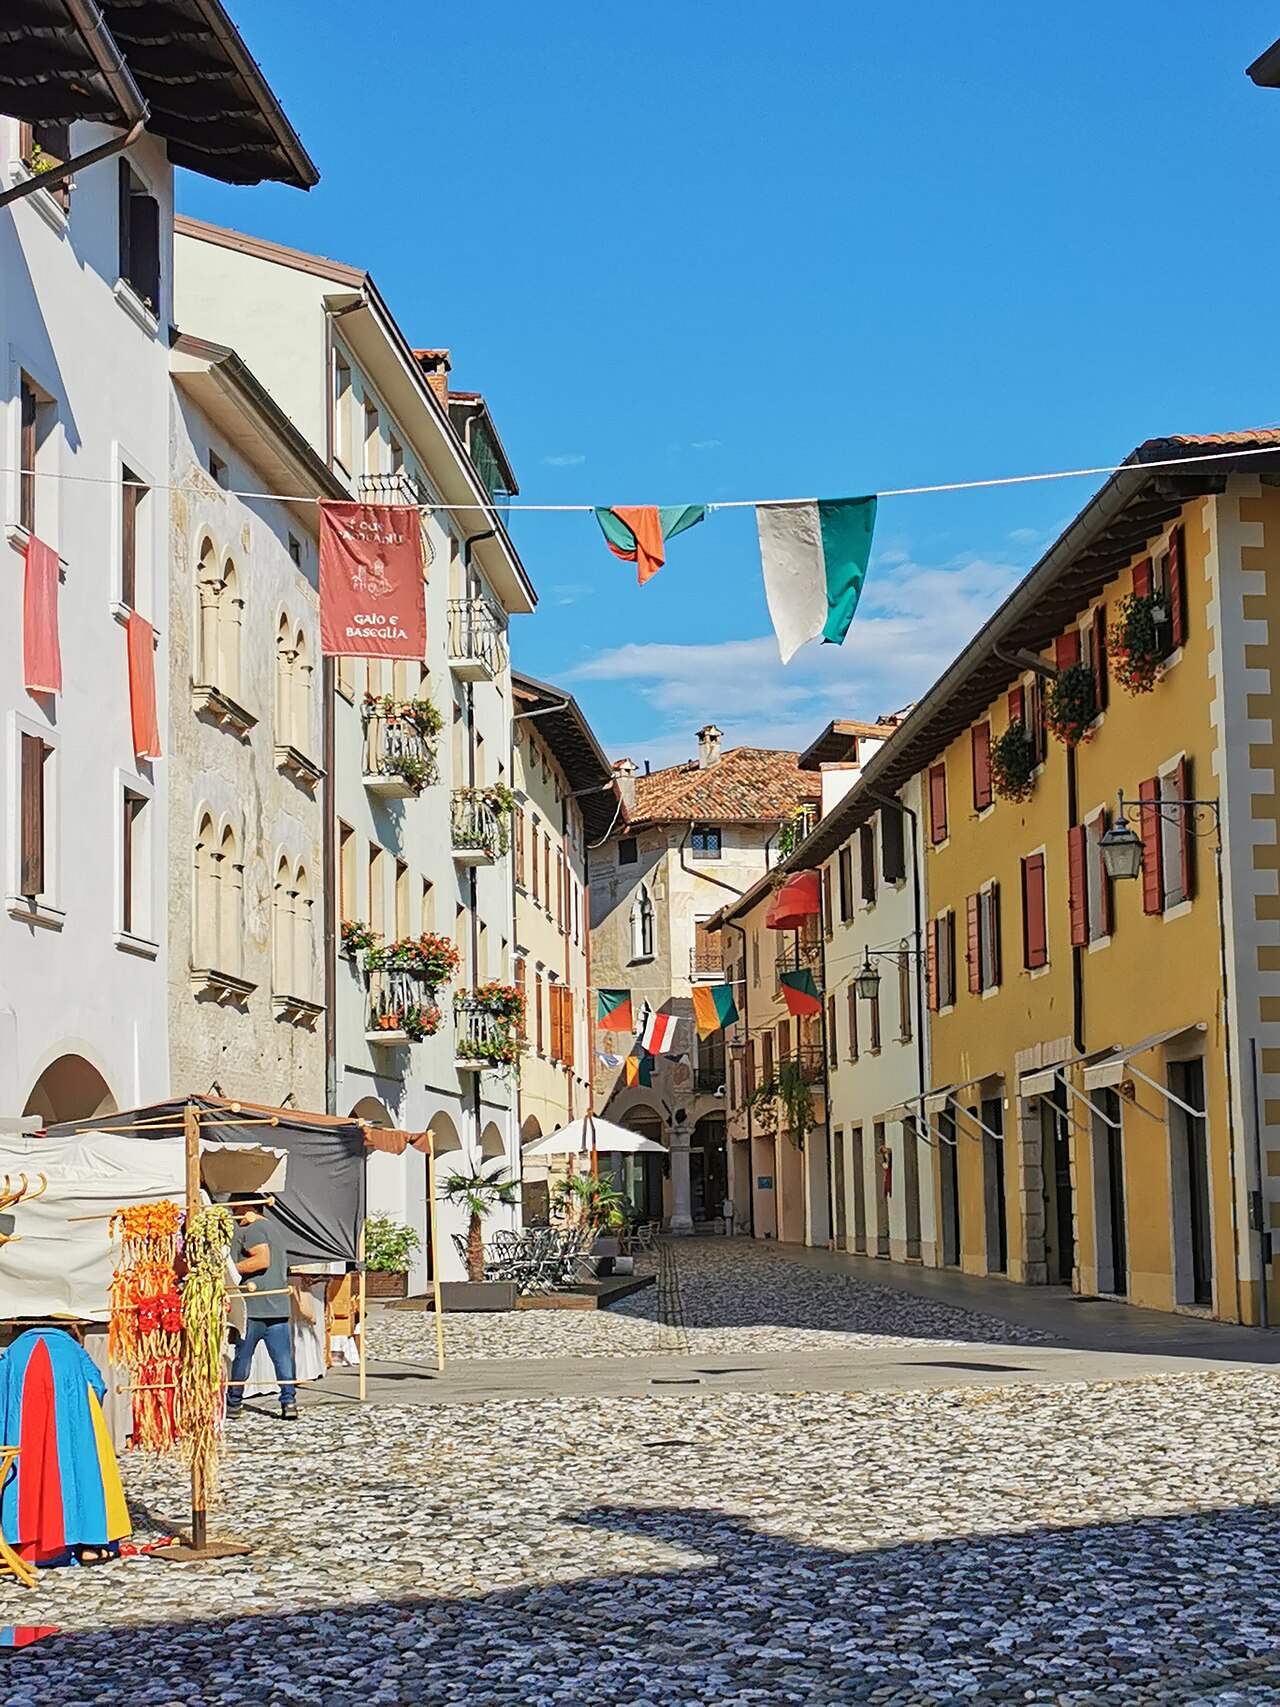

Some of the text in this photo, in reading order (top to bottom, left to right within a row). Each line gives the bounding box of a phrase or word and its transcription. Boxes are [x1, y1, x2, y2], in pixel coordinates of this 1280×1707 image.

[354, 613, 399, 625] GAIO E
[346, 626, 408, 639] BASEGLIA
